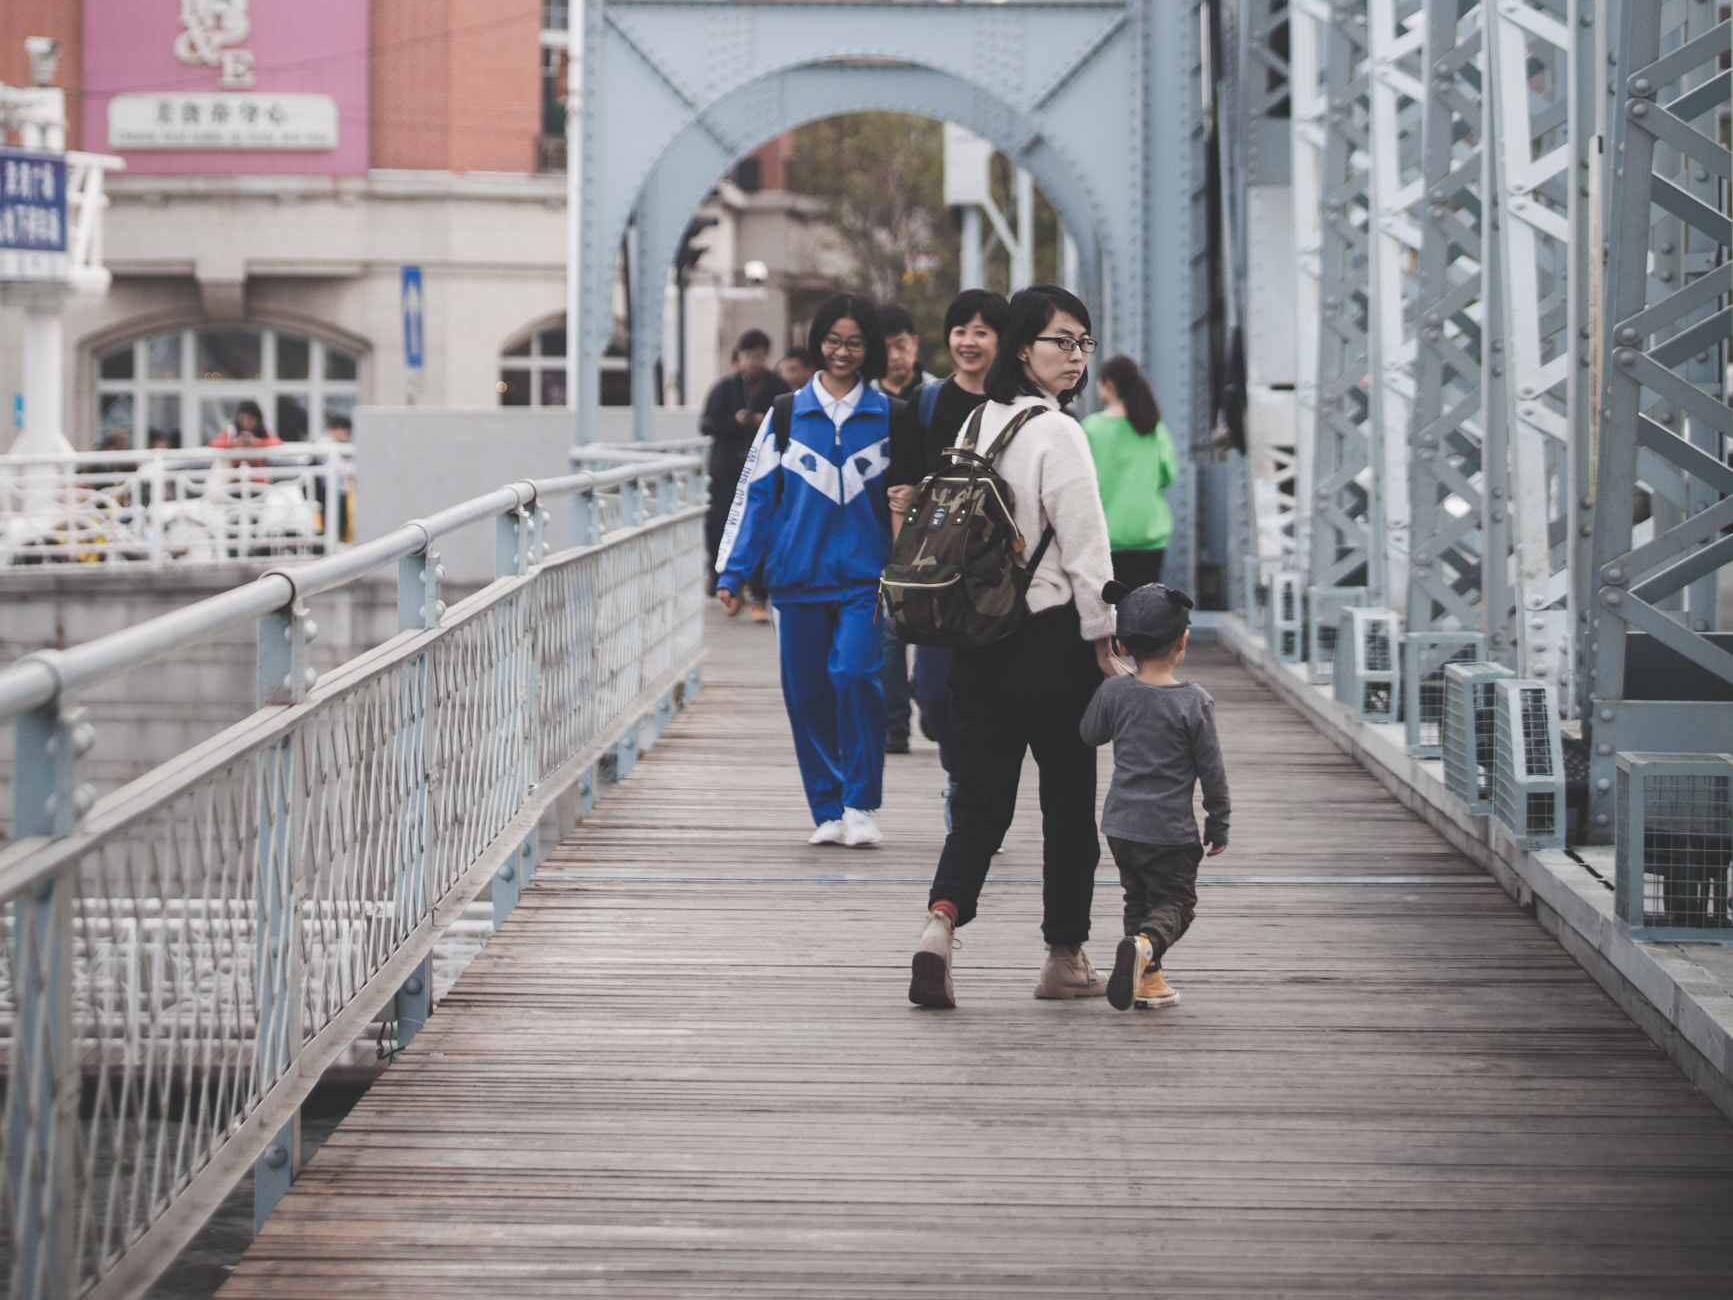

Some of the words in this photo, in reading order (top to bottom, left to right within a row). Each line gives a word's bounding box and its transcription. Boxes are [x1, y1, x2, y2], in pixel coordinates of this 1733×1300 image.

[746, 445, 757, 463] WU
[739, 466, 752, 484] SHI
[735, 488, 745, 506] LIU
[727, 509, 739, 526] WU
